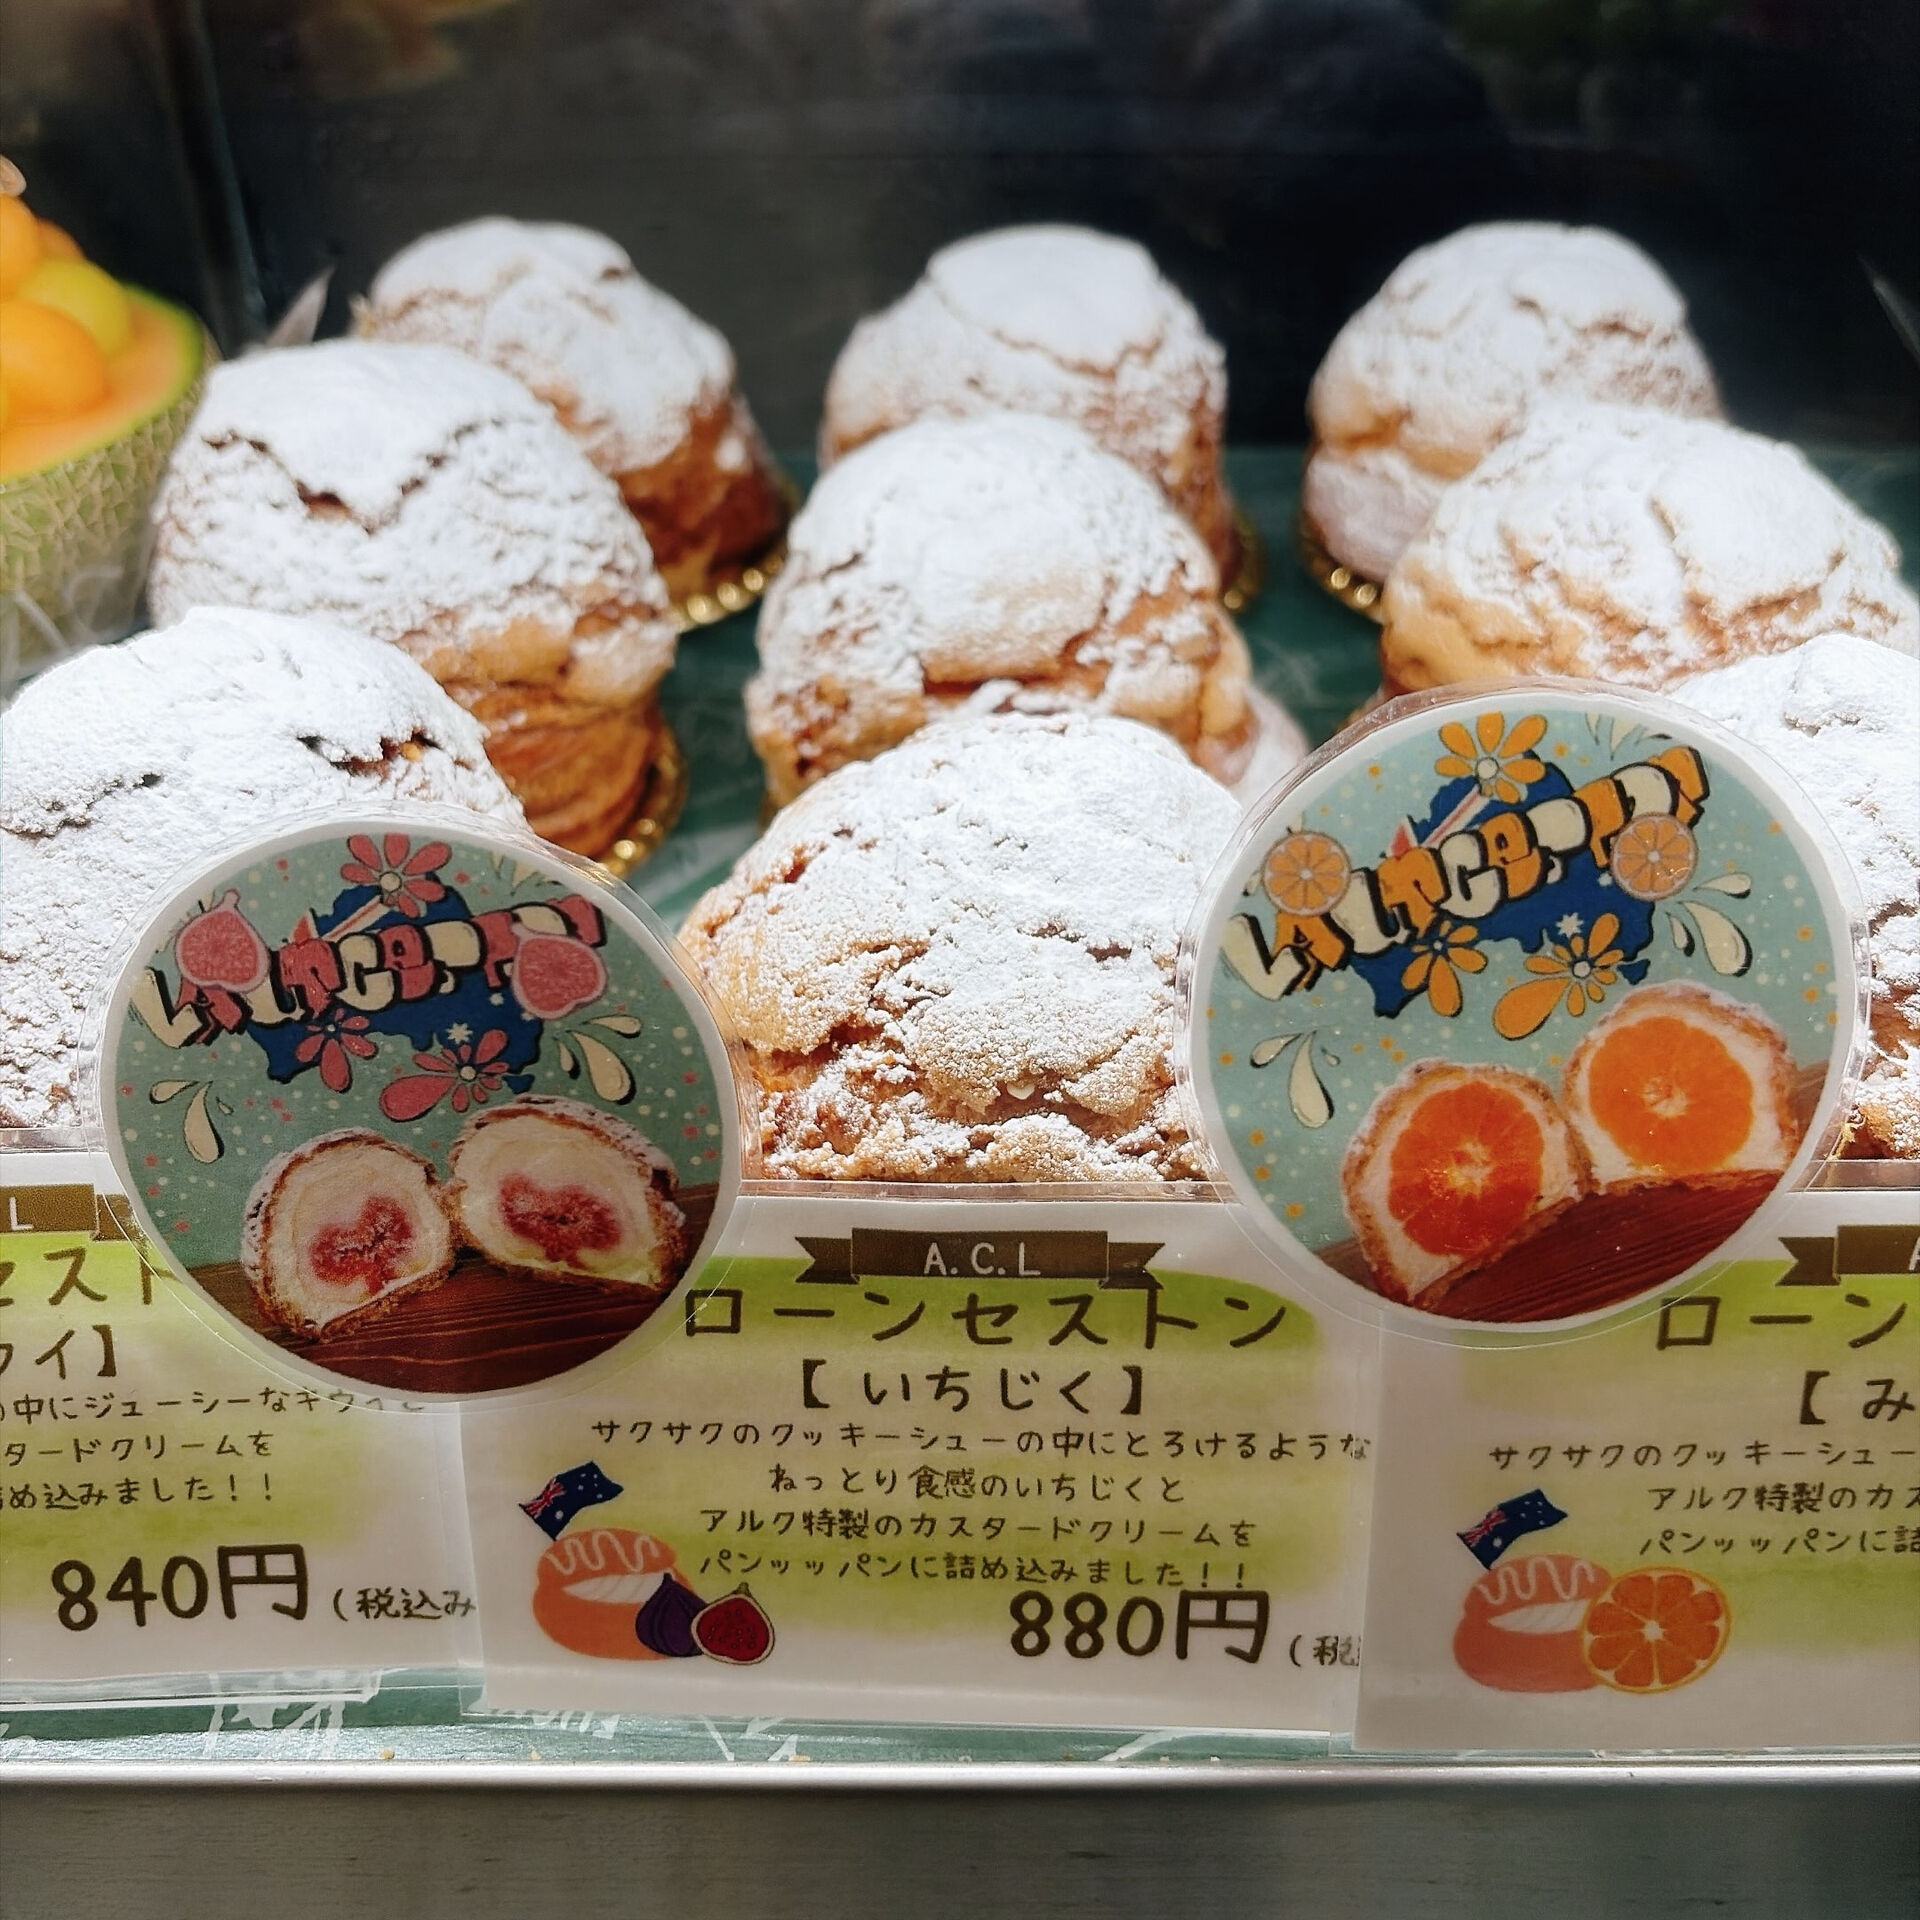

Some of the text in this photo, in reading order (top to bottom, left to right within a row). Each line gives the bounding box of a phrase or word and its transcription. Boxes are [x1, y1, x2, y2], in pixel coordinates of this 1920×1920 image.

[0, 1246, 181, 1306] スト
[923, 1242, 1041, 1276] A.C.L
[685, 1287, 1287, 1350] ローンセストン
[1657, 1293, 1907, 1351] ローン
[4, 1430, 274, 1467] タードクリームを
[1489, 1440, 1917, 1470] サクサクのクッキーシュー
[0, 1473, 272, 1510] め込みました！！
[768, 1462, 1185, 1503] ねっとり食感のいちじくと
[700, 1508, 1256, 1548] アルク特製のカスタードクリームを
[50, 1543, 309, 1632] 840円
[1009, 1589, 1270, 1664] 880円
